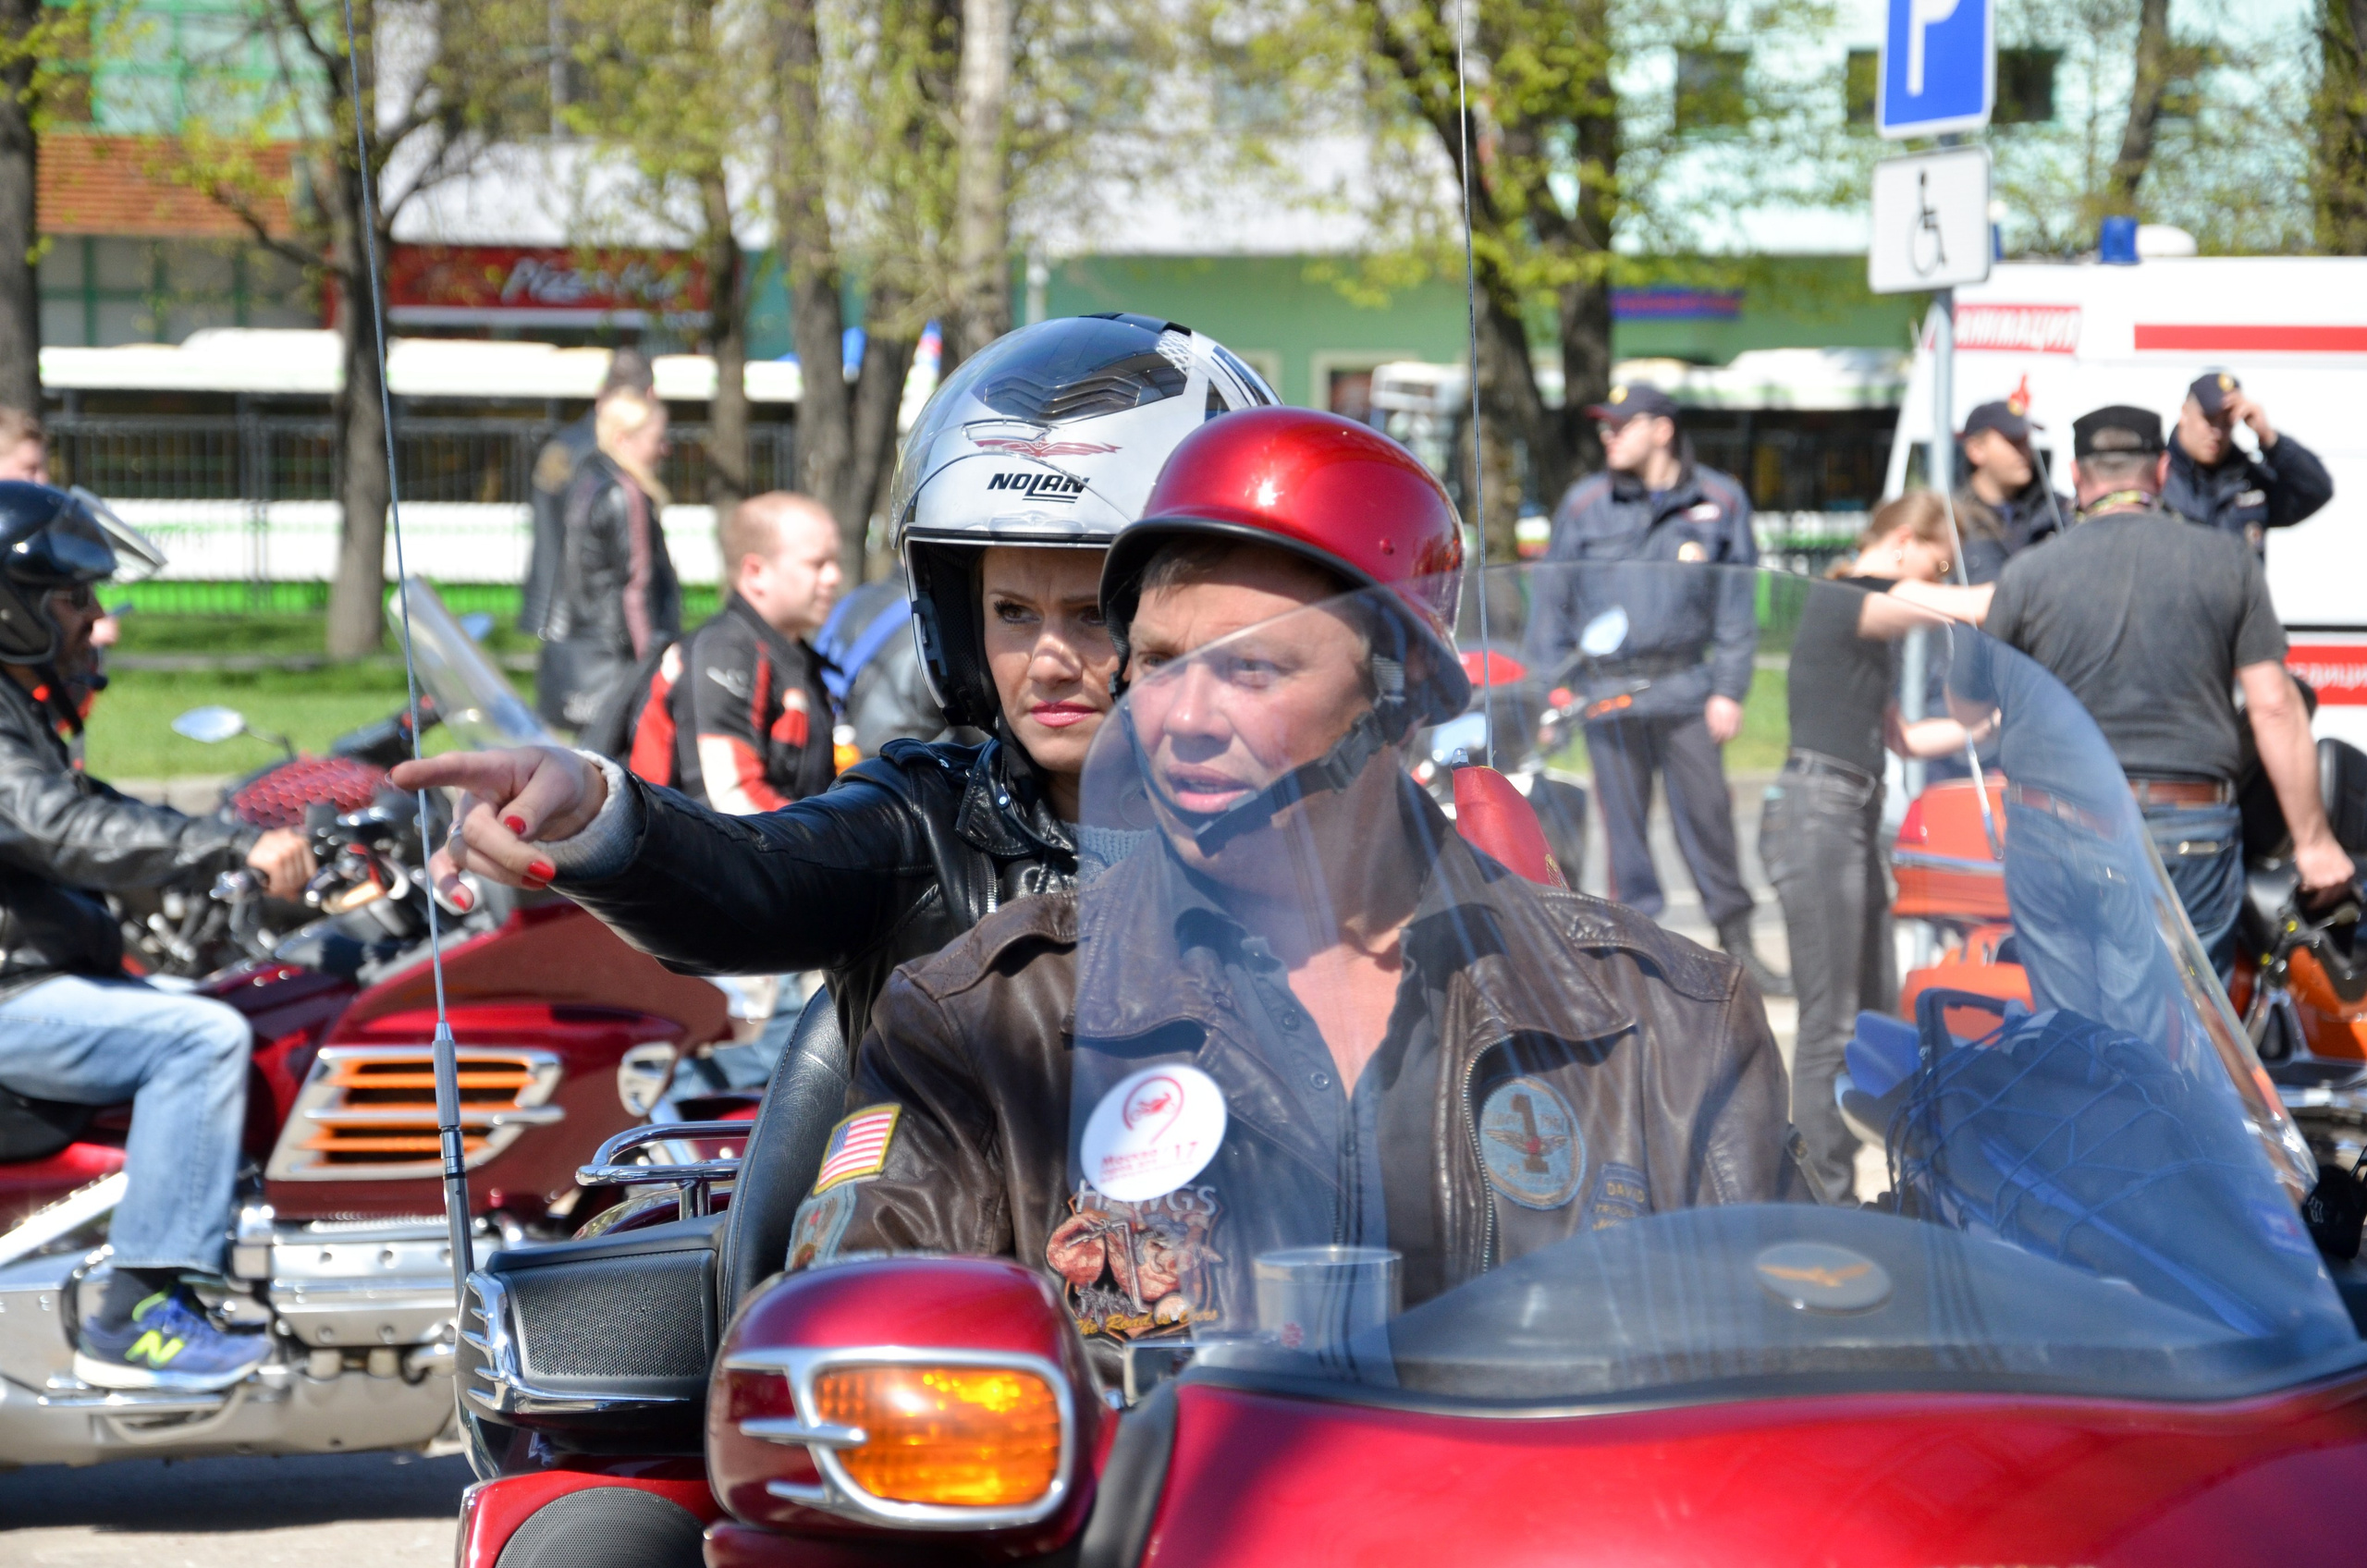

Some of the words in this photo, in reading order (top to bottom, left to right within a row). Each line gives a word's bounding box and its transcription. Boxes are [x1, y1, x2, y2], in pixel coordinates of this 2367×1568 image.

[1906, 0, 1963, 97] P
[987, 472, 1090, 504] NOLAN
[1076, 1178, 1217, 1218] HWGS
[1105, 1311, 1154, 1334] Road
[1156, 1314, 1172, 1326] is
